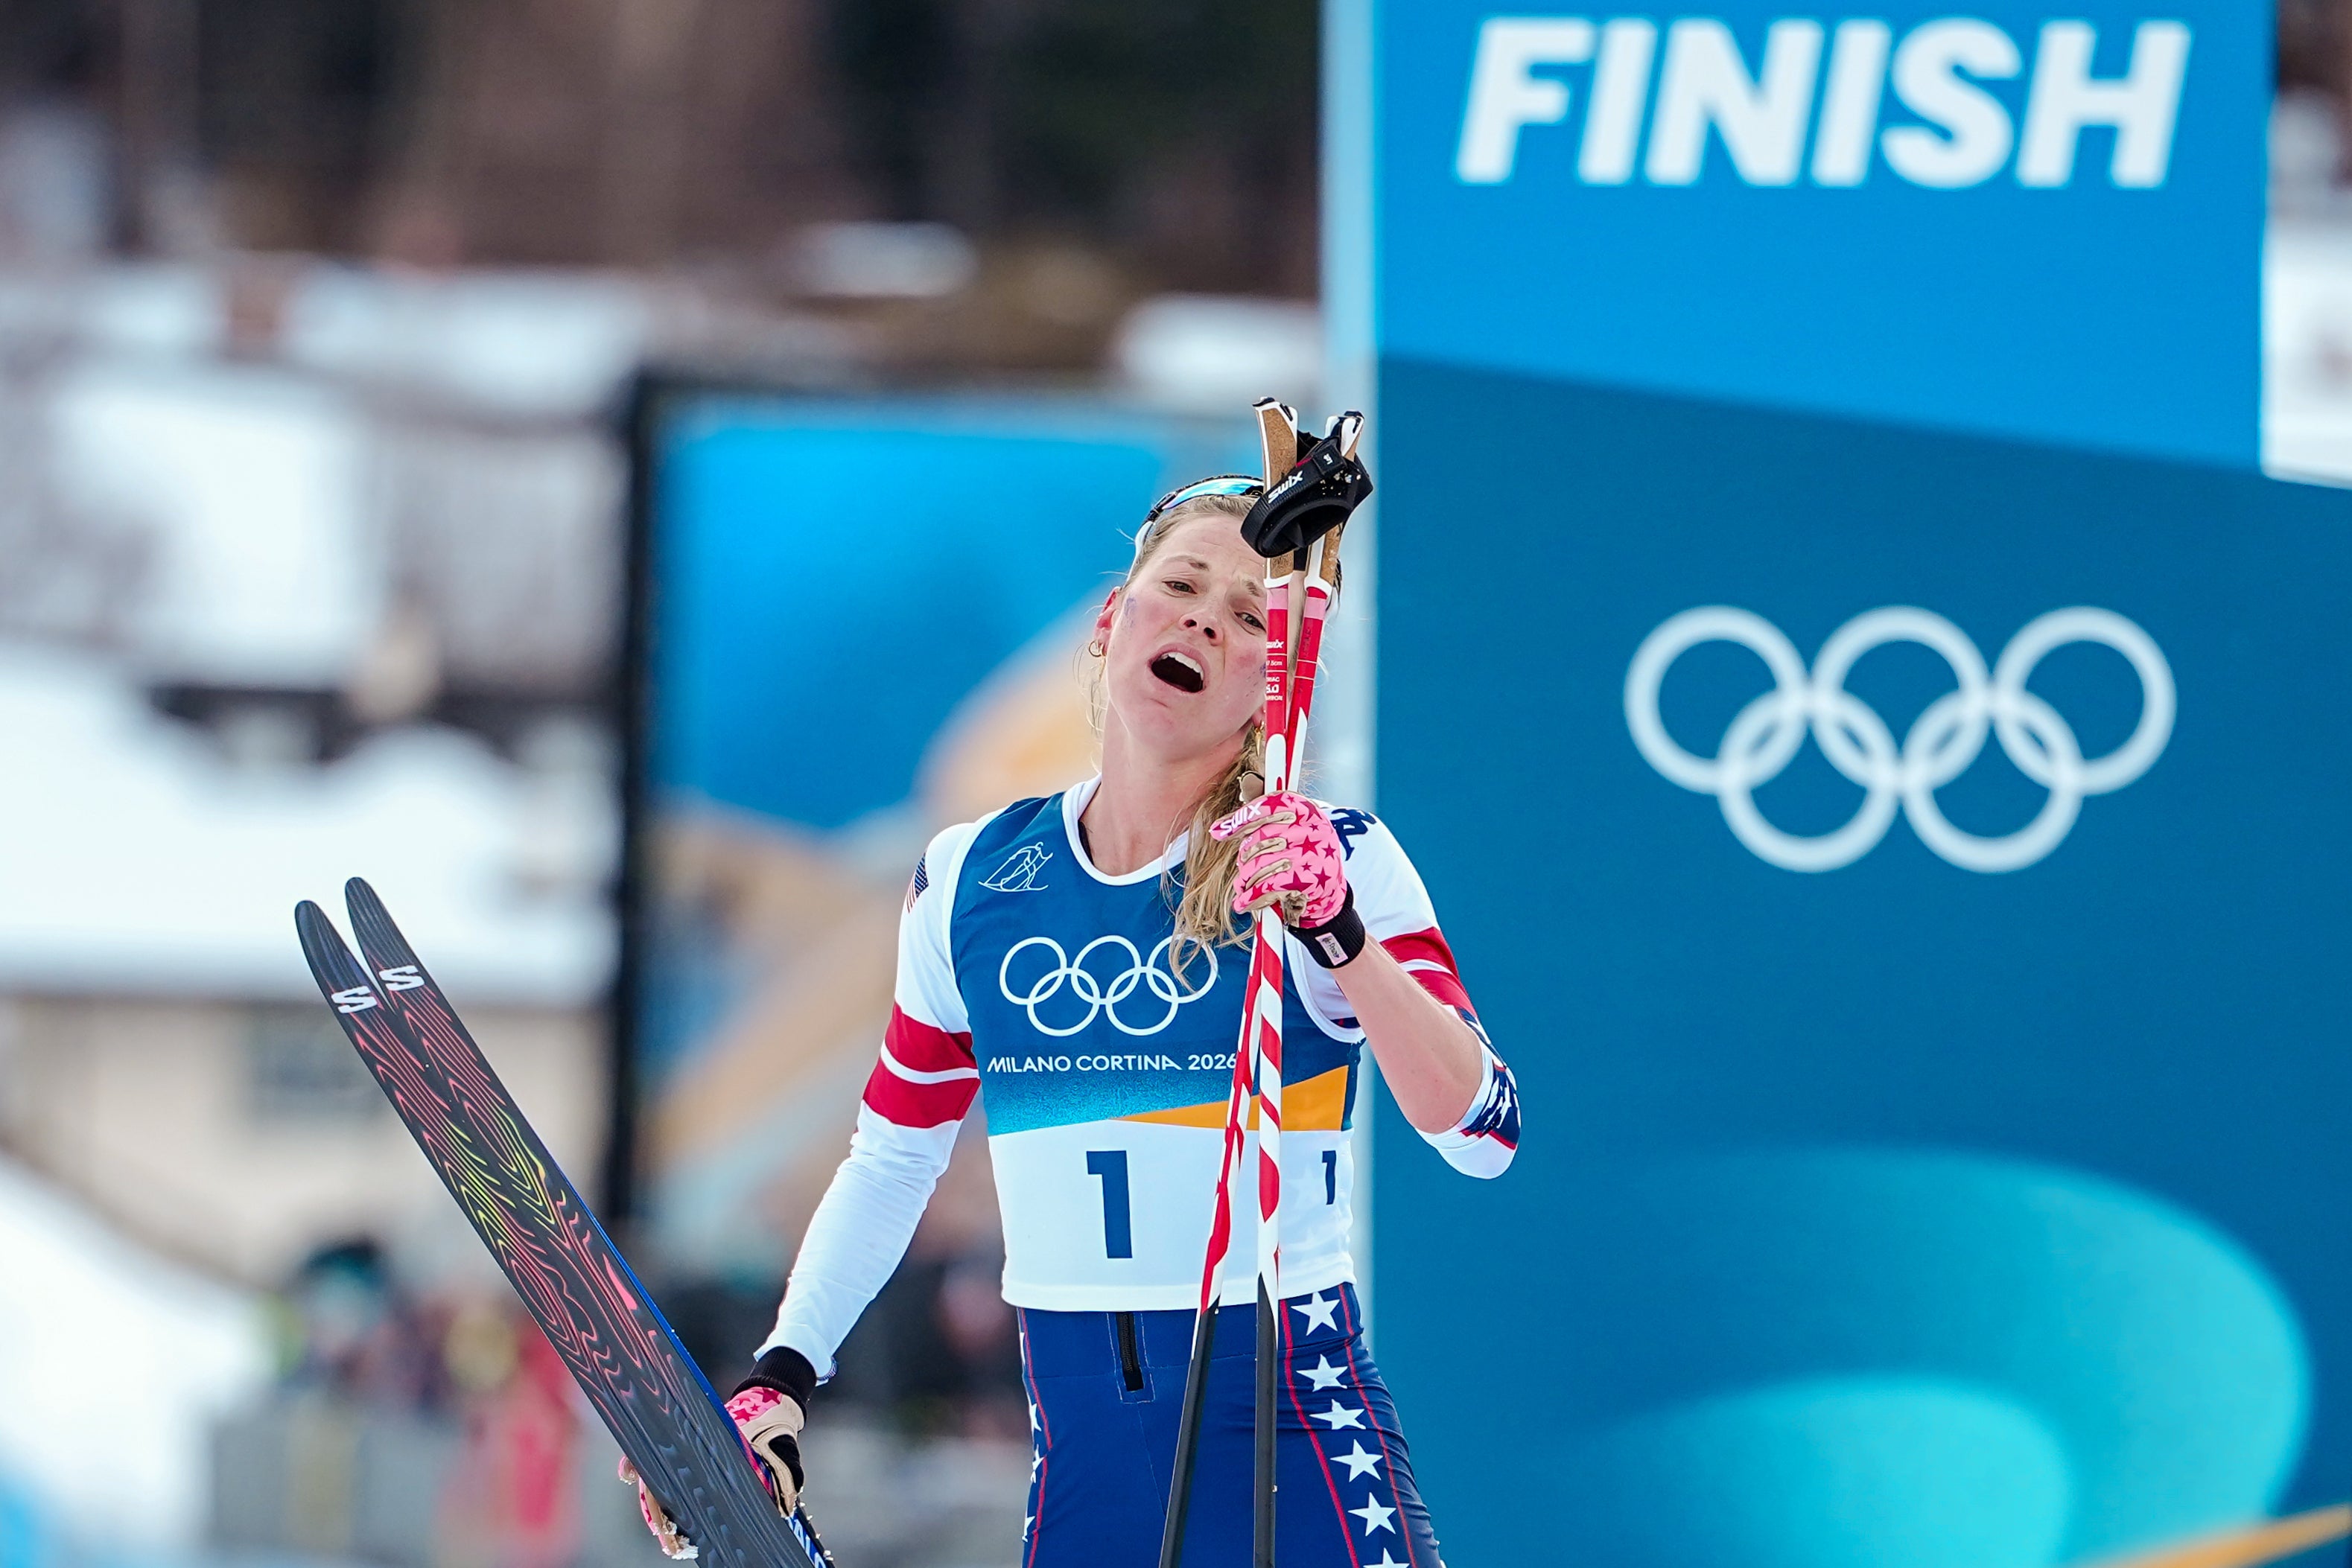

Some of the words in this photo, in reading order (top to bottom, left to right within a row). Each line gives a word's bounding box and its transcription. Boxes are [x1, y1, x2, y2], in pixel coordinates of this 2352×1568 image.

[1456, 17, 2190, 188] FINISH
[987, 1056, 1072, 1073] MILANO
[1075, 1054, 1183, 1071] CORTINA
[1188, 1053, 1236, 1071] 2026
[1086, 1150, 1134, 1259] 1
[1321, 1150, 1337, 1205] 1
